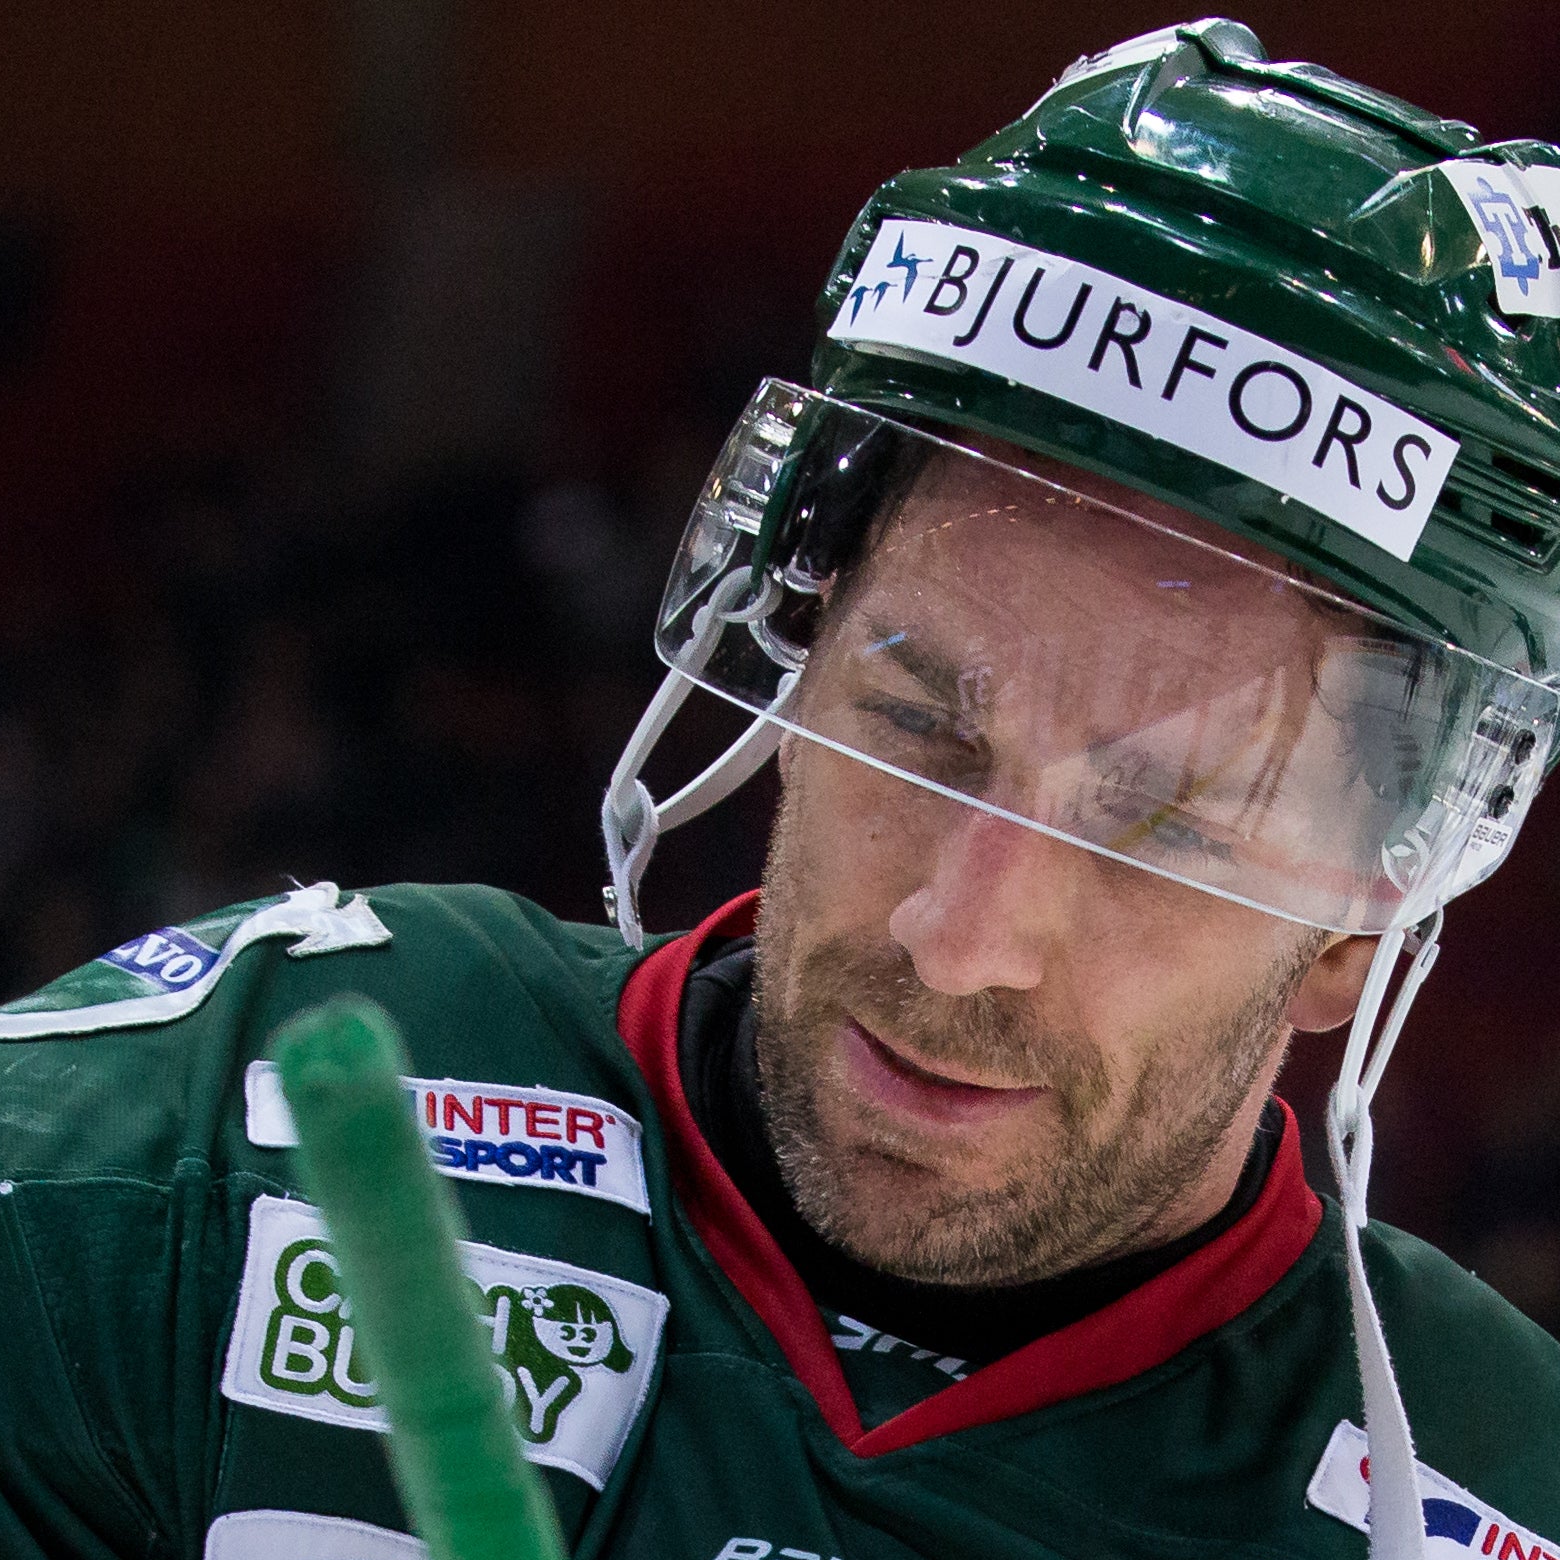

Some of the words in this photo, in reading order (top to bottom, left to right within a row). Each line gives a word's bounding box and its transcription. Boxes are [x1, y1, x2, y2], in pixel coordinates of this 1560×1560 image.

[925, 246, 1432, 512] BJURFORS
[426, 1091, 605, 1149] INTER
[430, 1135, 607, 1187] SPORT
